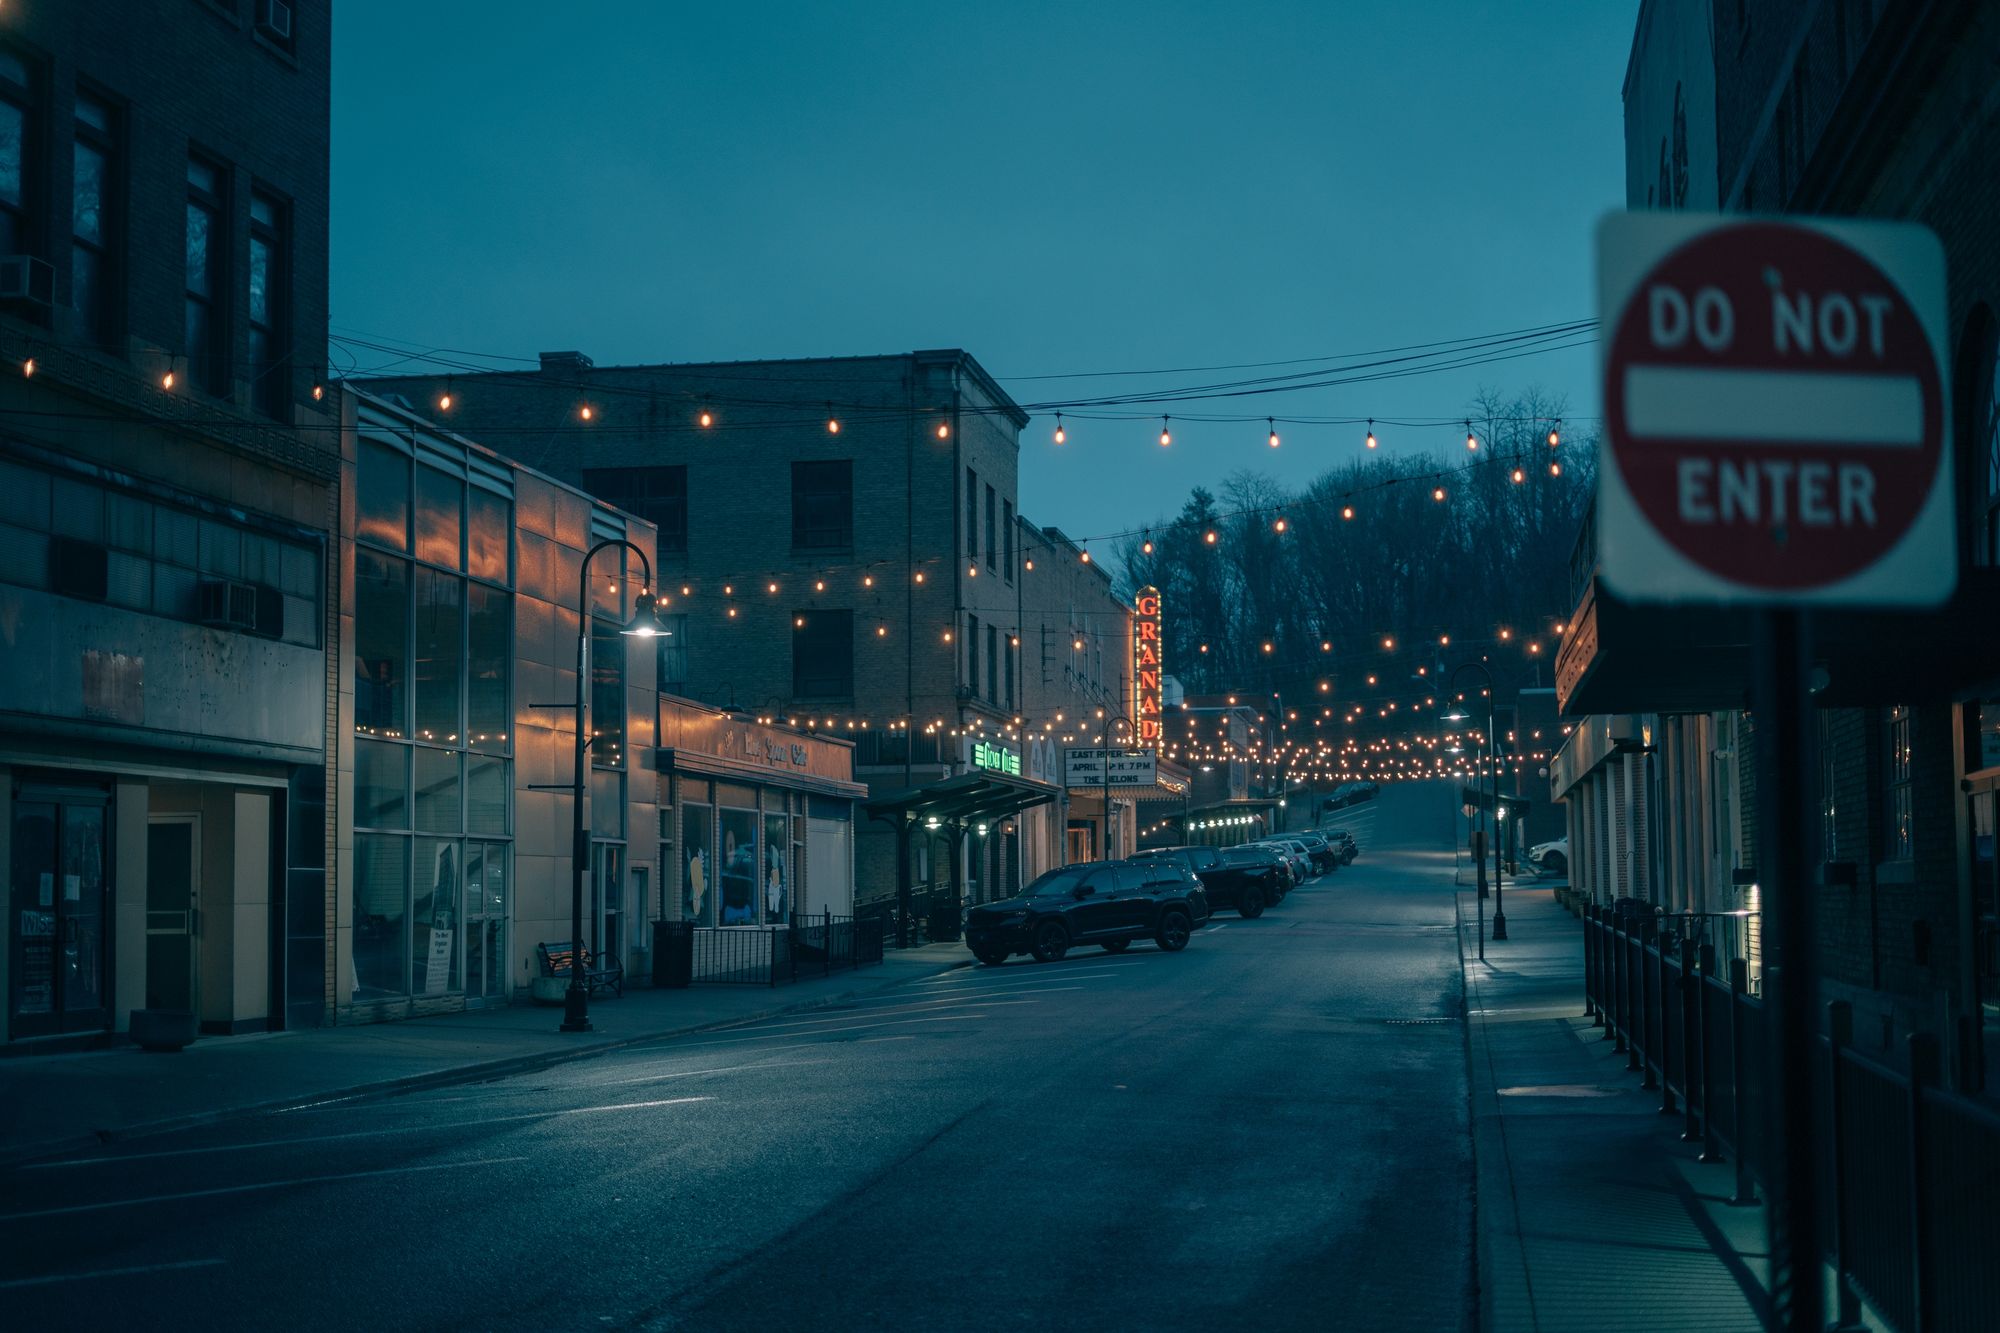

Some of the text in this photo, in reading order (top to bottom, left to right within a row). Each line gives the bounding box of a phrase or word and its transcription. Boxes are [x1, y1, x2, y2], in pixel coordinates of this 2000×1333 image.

[1648, 284, 1894, 359] DO NOT
[1677, 457, 1879, 529] ENTER
[1096, 750, 1122, 758] RIER
[1073, 763, 1099, 771] APRIL
[1083, 775, 1138, 784] THE ELONS
